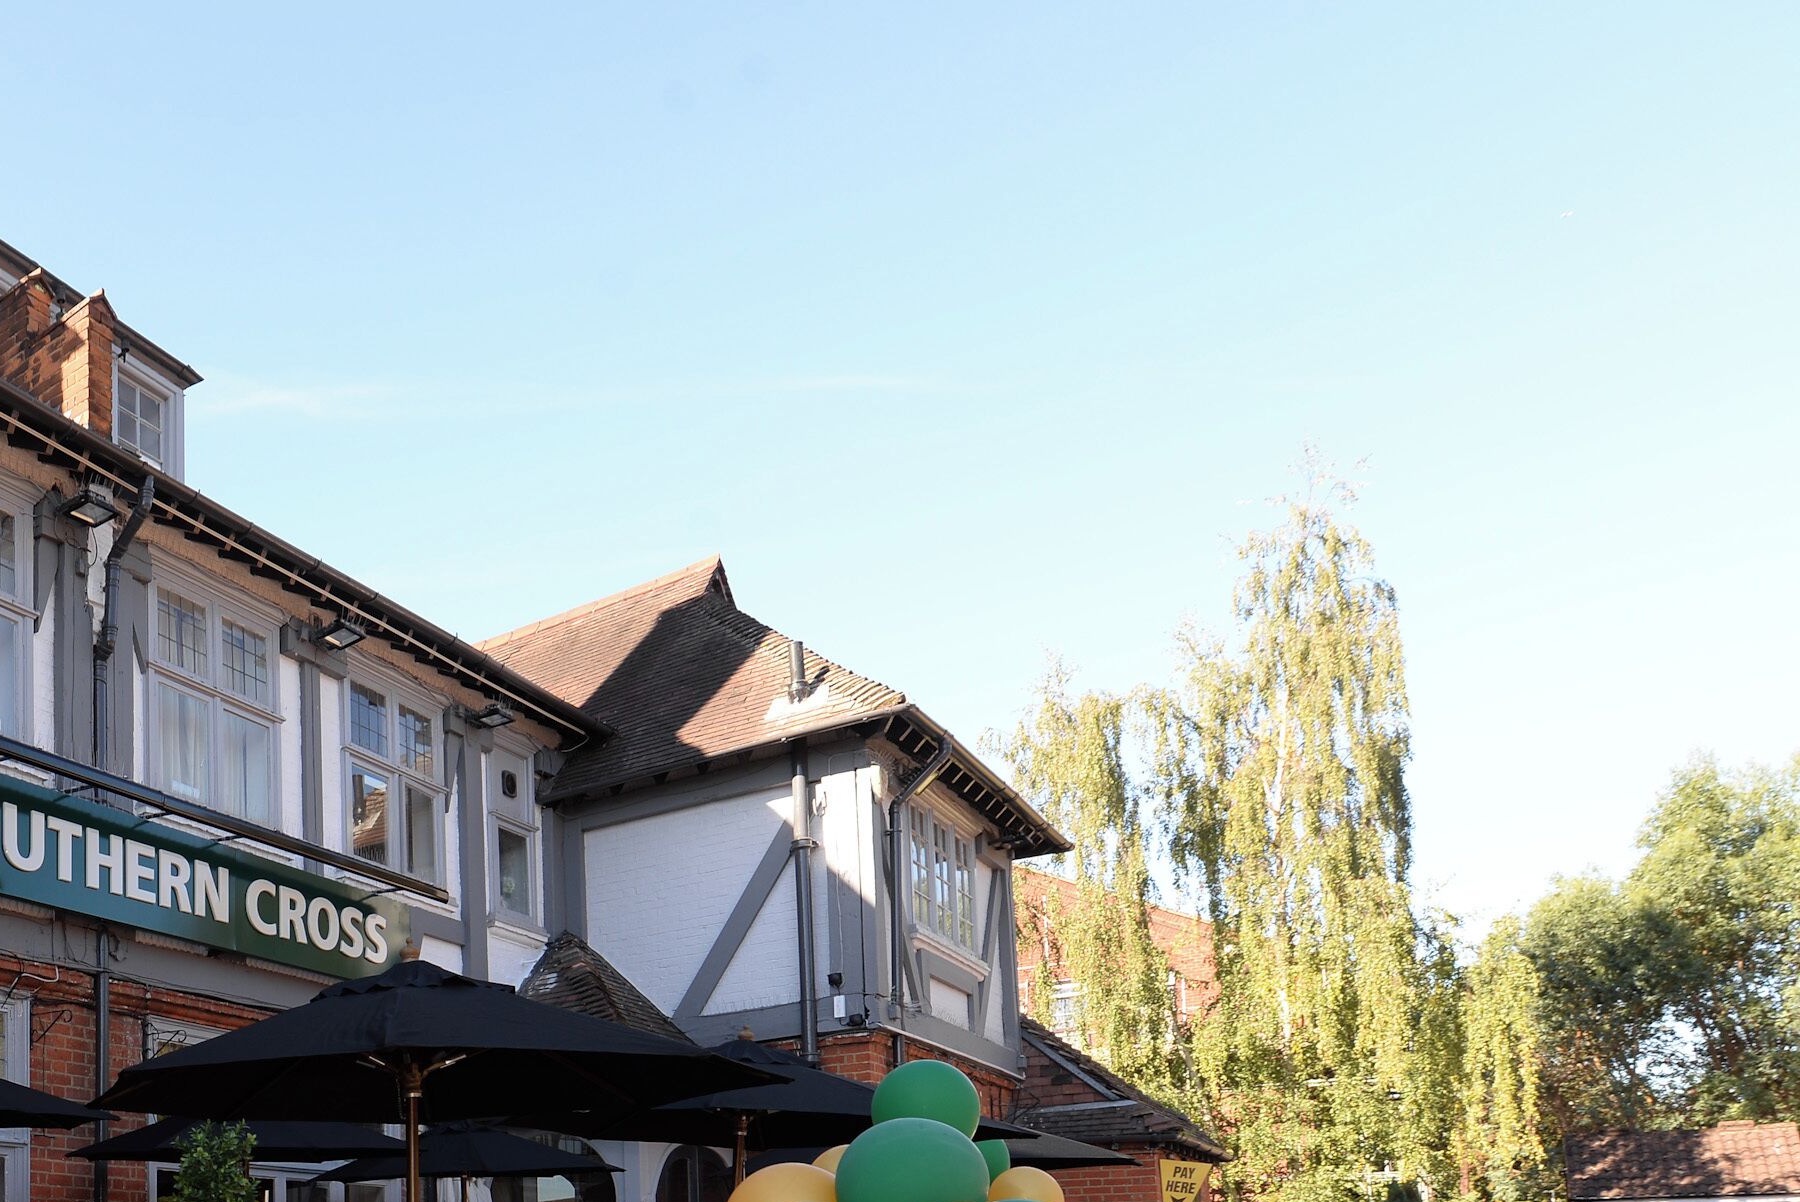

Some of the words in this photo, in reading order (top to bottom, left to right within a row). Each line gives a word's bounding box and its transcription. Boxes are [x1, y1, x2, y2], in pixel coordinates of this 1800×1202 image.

[245, 879, 388, 964] CROSS
[1173, 1166, 1196, 1179] PAY
[1165, 1180, 1197, 1194] HERE
